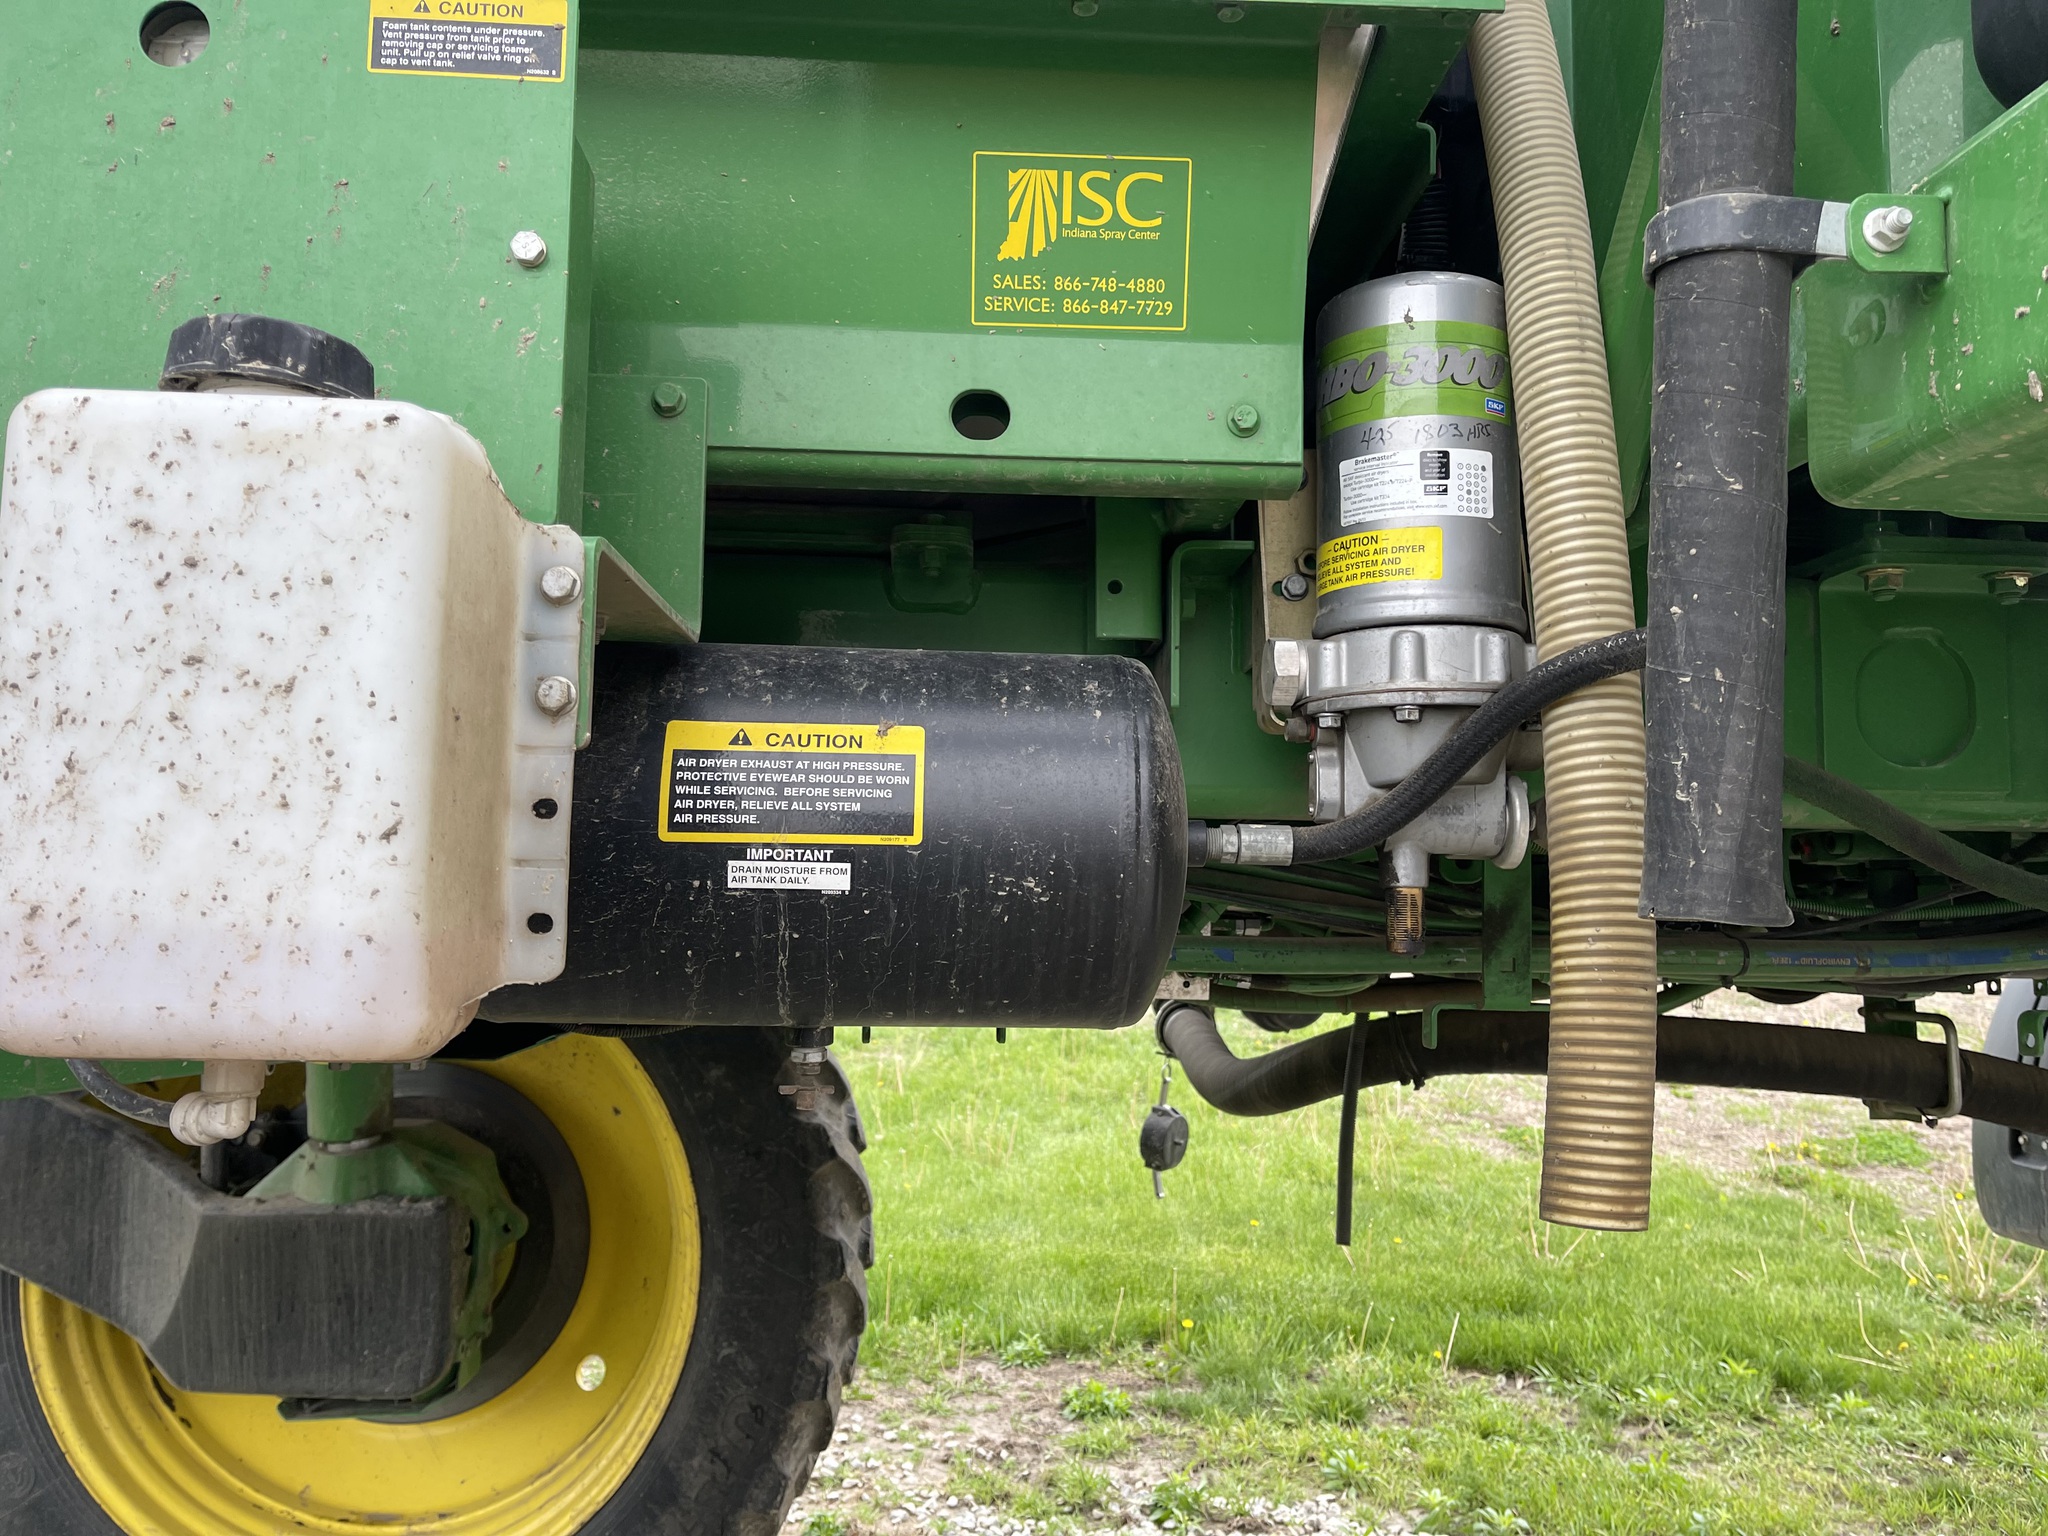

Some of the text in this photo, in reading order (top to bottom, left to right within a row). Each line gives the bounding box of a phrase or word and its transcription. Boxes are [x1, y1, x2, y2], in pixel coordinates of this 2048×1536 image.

[439, 1, 524, 18] CAUTION
[382, 21, 545, 38] Foam tank contents under pressure.
[382, 30, 526, 45] Vent pressure from tank prior to
[381, 40, 424, 50] removing
[426, 42, 443, 51] cap
[458, 43, 499, 53] servicing
[502, 44, 533, 54] foamer
[381, 48, 401, 56] unit.
[404, 48, 421, 57] Pull
[424, 50, 435, 59] up
[452, 51, 475, 60] relief
[477, 52, 501, 61] valve
[503, 54, 522, 64] ring
[381, 58, 397, 66] cap
[432, 59, 455, 68] tank.
[1062, 170, 1164, 228] ISC
[1062, 228, 1160, 242] Indiana Spray Center
[993, 274, 1165, 294] SALES: 866-748-4880
[984, 296, 1173, 316] SERVICE: 866-847-7729
[1333, 535, 1378, 552] CAUTION
[1332, 550, 1370, 563] SERVICING
[1372, 547, 1388, 556] AIR
[1391, 545, 1425, 554] DRYER
[1332, 565, 1343, 575] ALL
[1346, 559, 1378, 572] SYSTEM
[1381, 557, 1401, 566] AND
[1328, 576, 1343, 589] TANK
[1345, 572, 1358, 582] AIR
[1360, 567, 1415, 579] PRESSURE!
[765, 732, 863, 749] CAUTION
[677, 758, 905, 772] AIR DRYER EXHAUST AT HIGH PRESSURE.
[676, 771, 910, 785] PROTECTIVE EYEWEAR SHOULD BE WORN
[675, 785, 892, 798] WHILE SERVICING. BEFORE SERVICING
[674, 799, 861, 812] AIR DRYER, RELIEVE ALL SYSTEM
[673, 813, 760, 824] AIR PRESSURE.
[746, 848, 833, 862] IMPORTANT
[731, 865, 848, 876] DRAIN MOISTURE FROM
[731, 875, 810, 885] AIR TANK DAILY.
